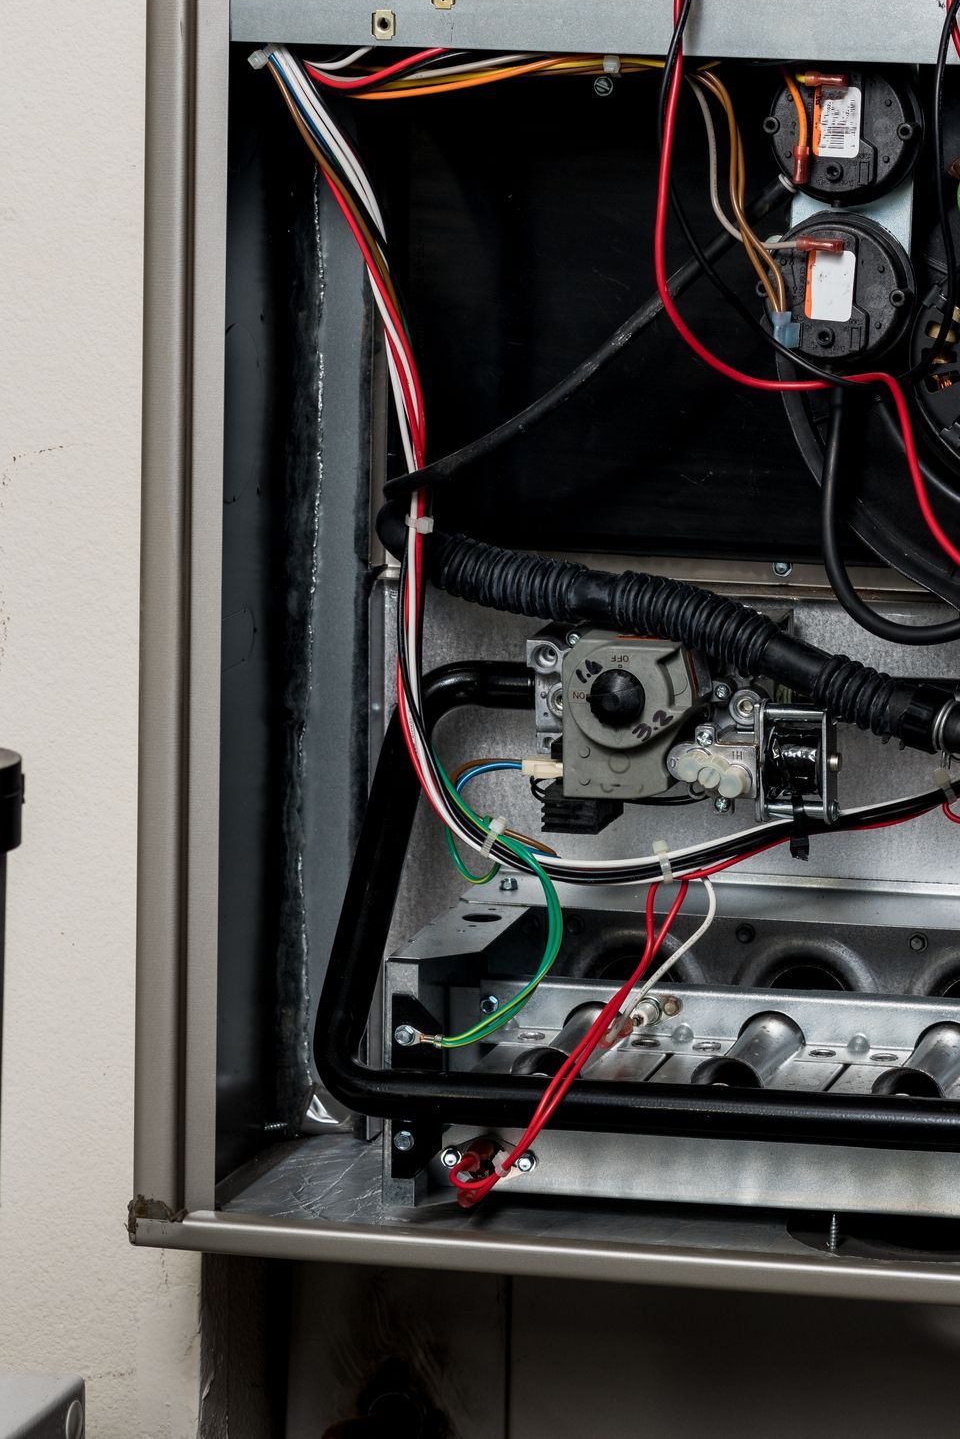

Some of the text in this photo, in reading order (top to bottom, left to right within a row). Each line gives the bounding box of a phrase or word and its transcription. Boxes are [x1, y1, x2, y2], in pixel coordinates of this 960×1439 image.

[611, 655, 630, 663] OFF
[572, 691, 585, 700] ON
[631, 709, 674, 742] 3.2
